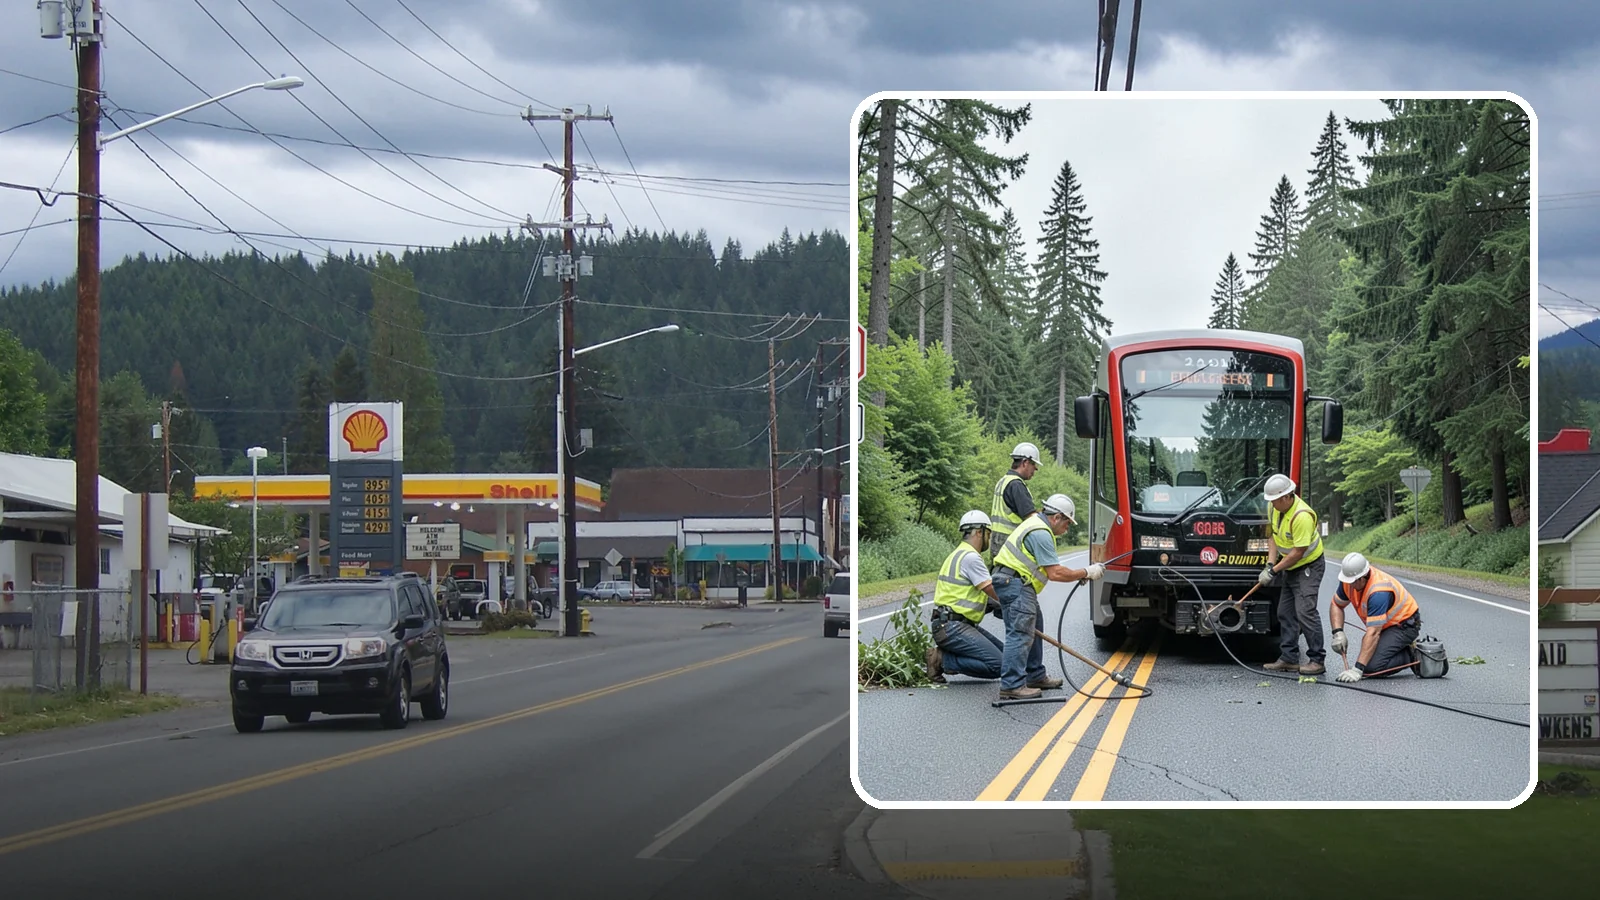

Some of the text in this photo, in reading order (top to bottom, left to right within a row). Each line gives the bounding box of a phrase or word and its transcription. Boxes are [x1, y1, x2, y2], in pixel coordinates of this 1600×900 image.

[366, 480, 383, 491] 395
[490, 484, 547, 499] Shell
[366, 494, 383, 504] 405
[366, 508, 383, 518] 415
[366, 522, 383, 533] 429
[1539, 716, 1592, 739] WKENS
